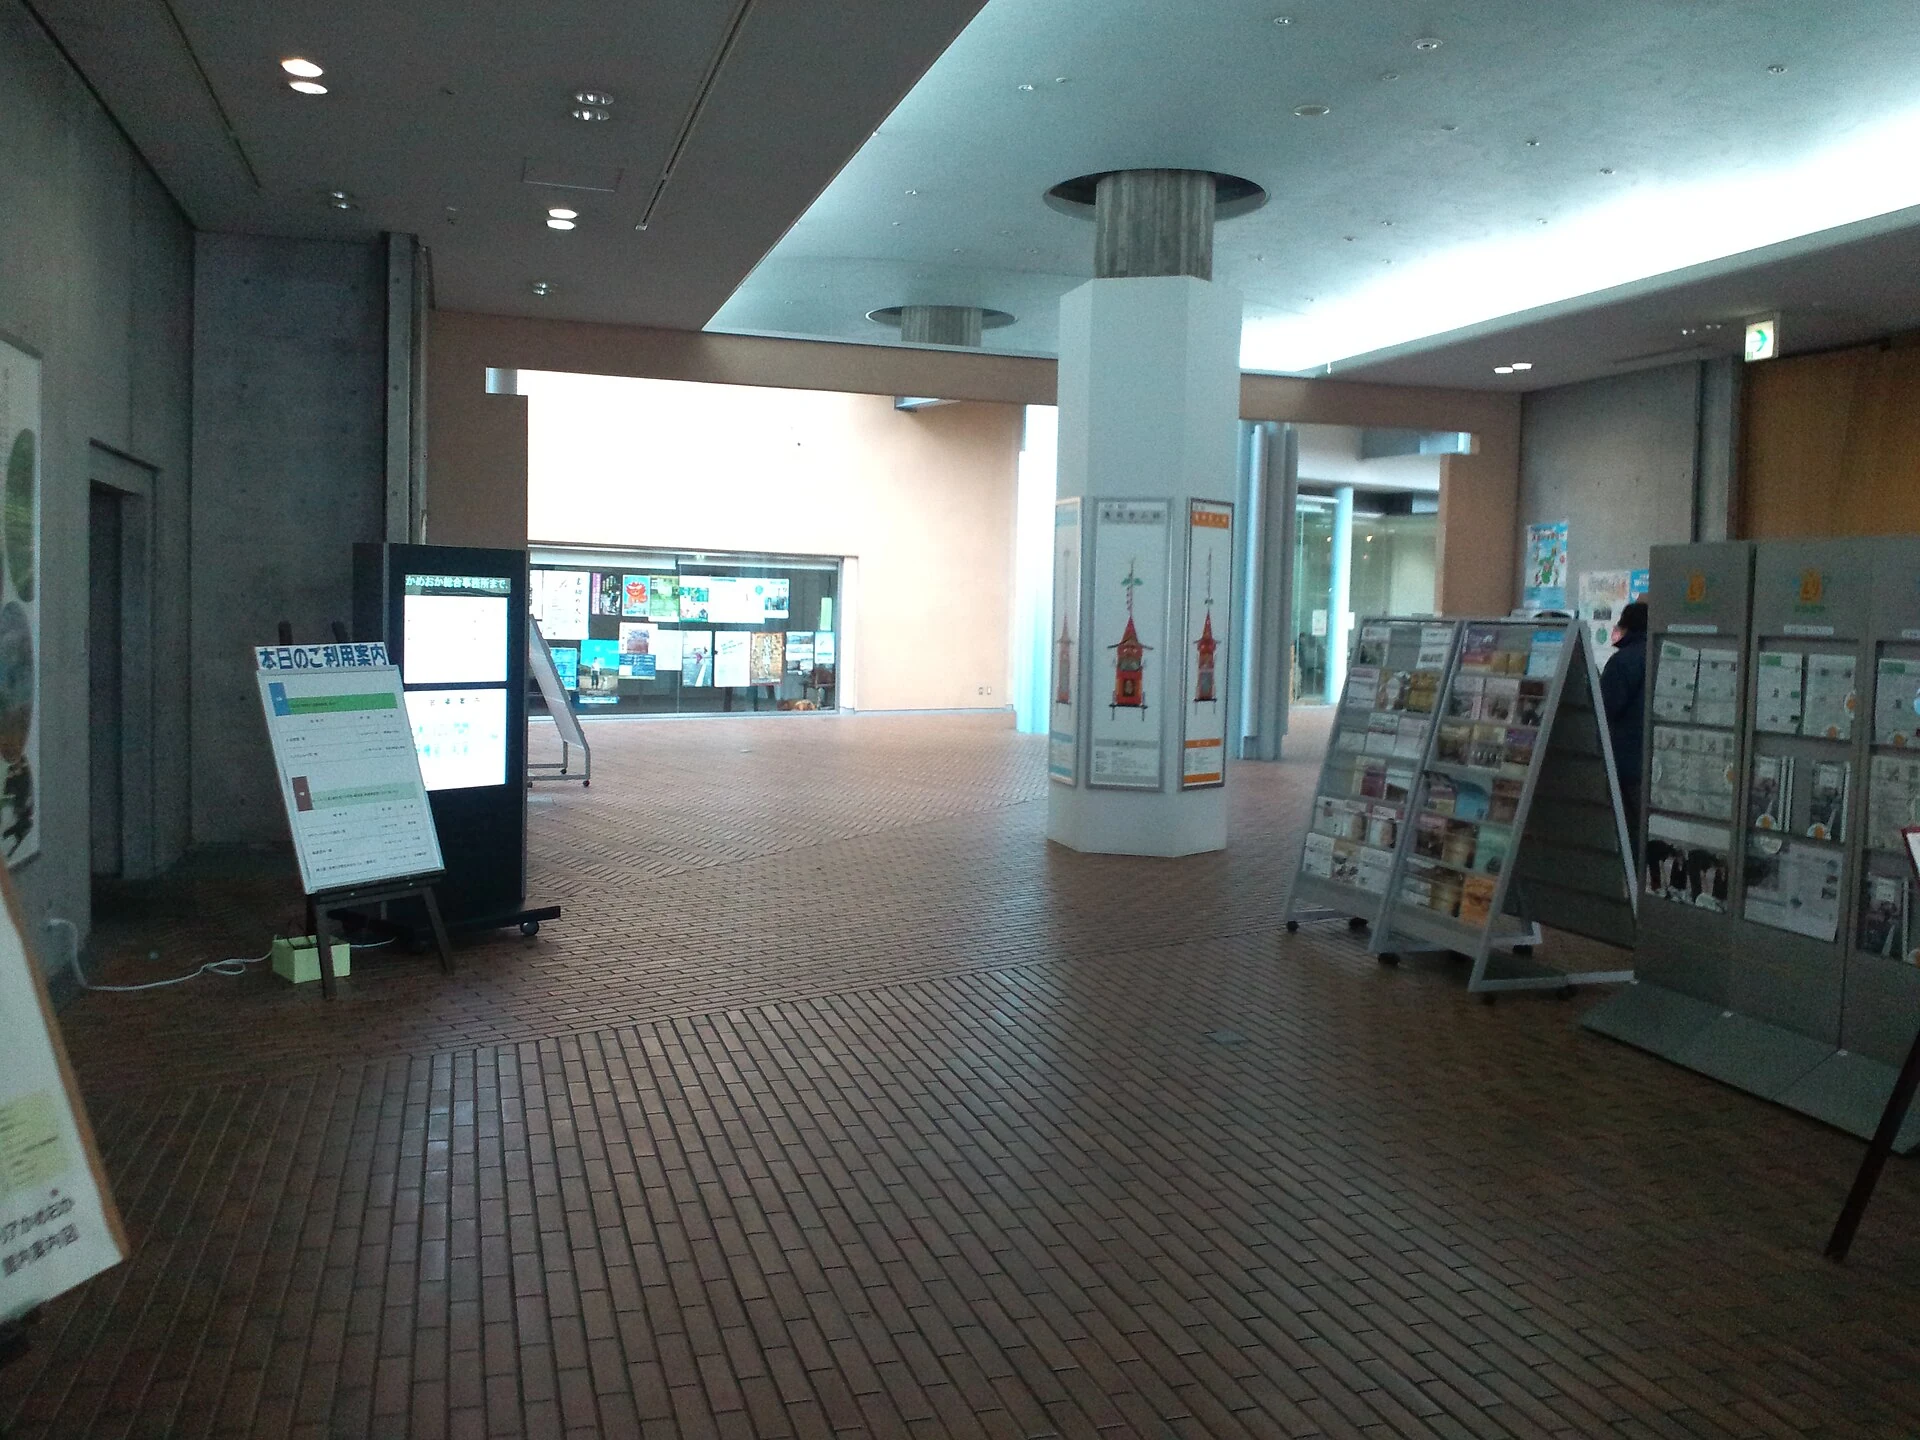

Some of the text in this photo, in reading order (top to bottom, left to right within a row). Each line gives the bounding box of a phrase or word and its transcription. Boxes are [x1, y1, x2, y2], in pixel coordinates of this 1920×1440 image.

[260, 644, 387, 670] 本日のご利用案内
